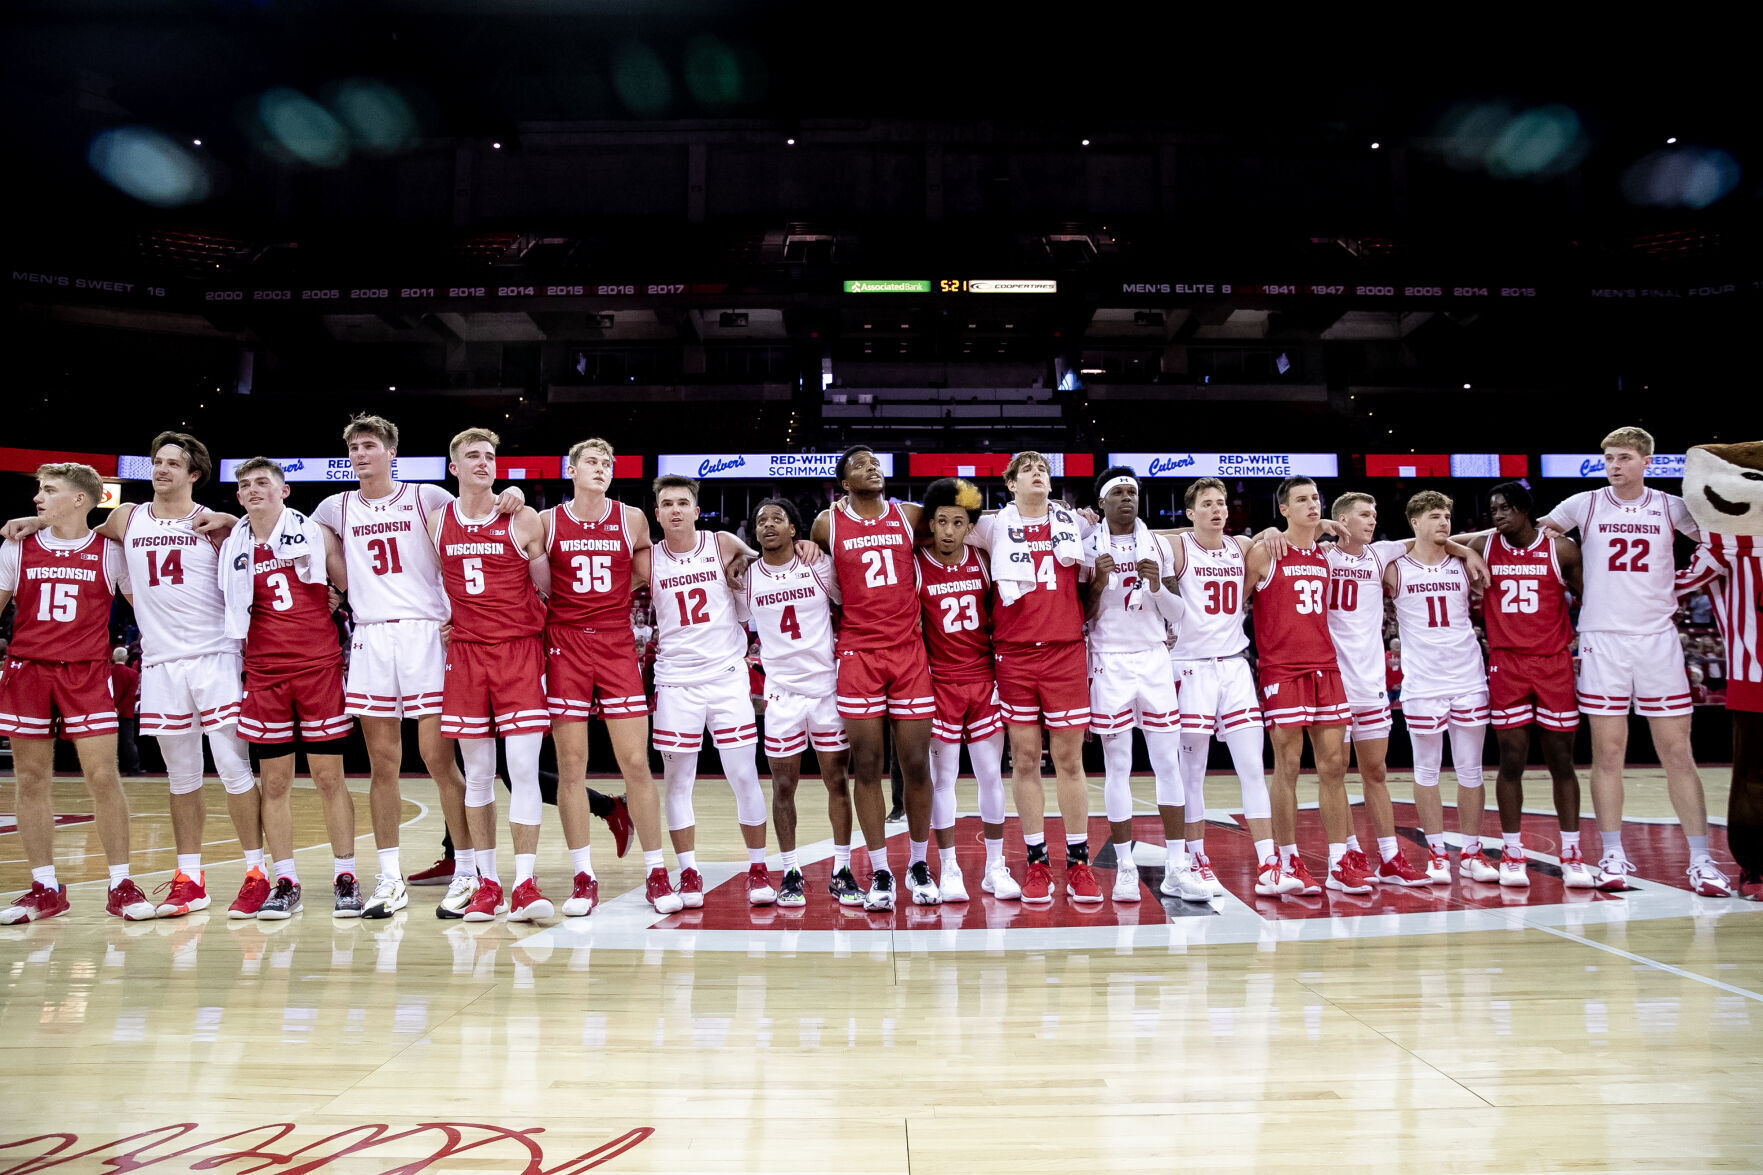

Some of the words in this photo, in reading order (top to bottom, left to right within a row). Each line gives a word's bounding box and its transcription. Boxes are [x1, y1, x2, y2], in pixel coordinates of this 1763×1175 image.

[12, 272, 70, 286] MEN'S
[75, 278, 135, 293] SWEET
[147, 287, 166, 297] 16
[204, 290, 243, 300] 2000
[253, 290, 291, 300] 2003
[301, 289, 340, 299] 2005
[351, 288, 389, 298] 2008
[400, 287, 434, 298] 2011
[449, 287, 486, 297] 2012
[498, 286, 534, 296] 2014
[547, 285, 584, 295] 2015
[598, 285, 635, 295] 2016
[648, 284, 684, 295] 2017
[1122, 283, 1171, 294] MEN'S
[1175, 283, 1215, 294] ELITE
[1221, 283, 1232, 294] 8
[1261, 285, 1296, 295] 1941
[1310, 285, 1345, 295] 1947
[1356, 285, 1394, 296] 2000
[1404, 286, 1443, 296] 2005
[1453, 287, 1488, 297] 2014
[1500, 287, 1536, 297] 2015
[1688, 283, 1736, 297] FOUR
[698, 455, 746, 478] Culver's
[1148, 454, 1196, 477] Culver's
[1219, 455, 1289, 465] RED-WHITE
[769, 466, 836, 476] SCRIMMAG
[1218, 466, 1291, 476] SCRIMMAGE
[352, 521, 411, 537] WISCONSIN
[1599, 523, 1661, 535] WISCONSIN
[132, 535, 198, 548] WISCONSIN
[445, 543, 504, 557] WISCONSIN
[560, 539, 621, 552] WISCONSIN
[843, 533, 903, 551] WISCONSIN
[367, 537, 403, 576] 31
[1608, 537, 1650, 573] 22
[26, 566, 97, 582] WISCONSIN
[146, 548, 184, 588] 14
[462, 557, 486, 595] 5
[570, 554, 613, 594] 35
[861, 548, 898, 589] 21
[1037, 555, 1057, 591] 4
[1194, 566, 1243, 577] WISCONSIN
[1331, 567, 1373, 580] SCONSIN
[1491, 564, 1548, 576] WISCONSIN
[659, 570, 718, 590] WISCONSIN
[927, 578, 982, 596] WISCONSIN
[1406, 581, 1461, 594] WISCONSIN
[37, 582, 79, 622] 15
[266, 572, 294, 611] 3
[755, 586, 816, 607] WISCONSIN
[1203, 580, 1238, 615] 30
[1293, 579, 1324, 615] 33
[1329, 578, 1358, 612] 10
[1500, 579, 1539, 614] 25
[674, 588, 711, 626] 12
[940, 594, 979, 634] 23
[1425, 595, 1450, 628] 11
[780, 605, 802, 640] 4
